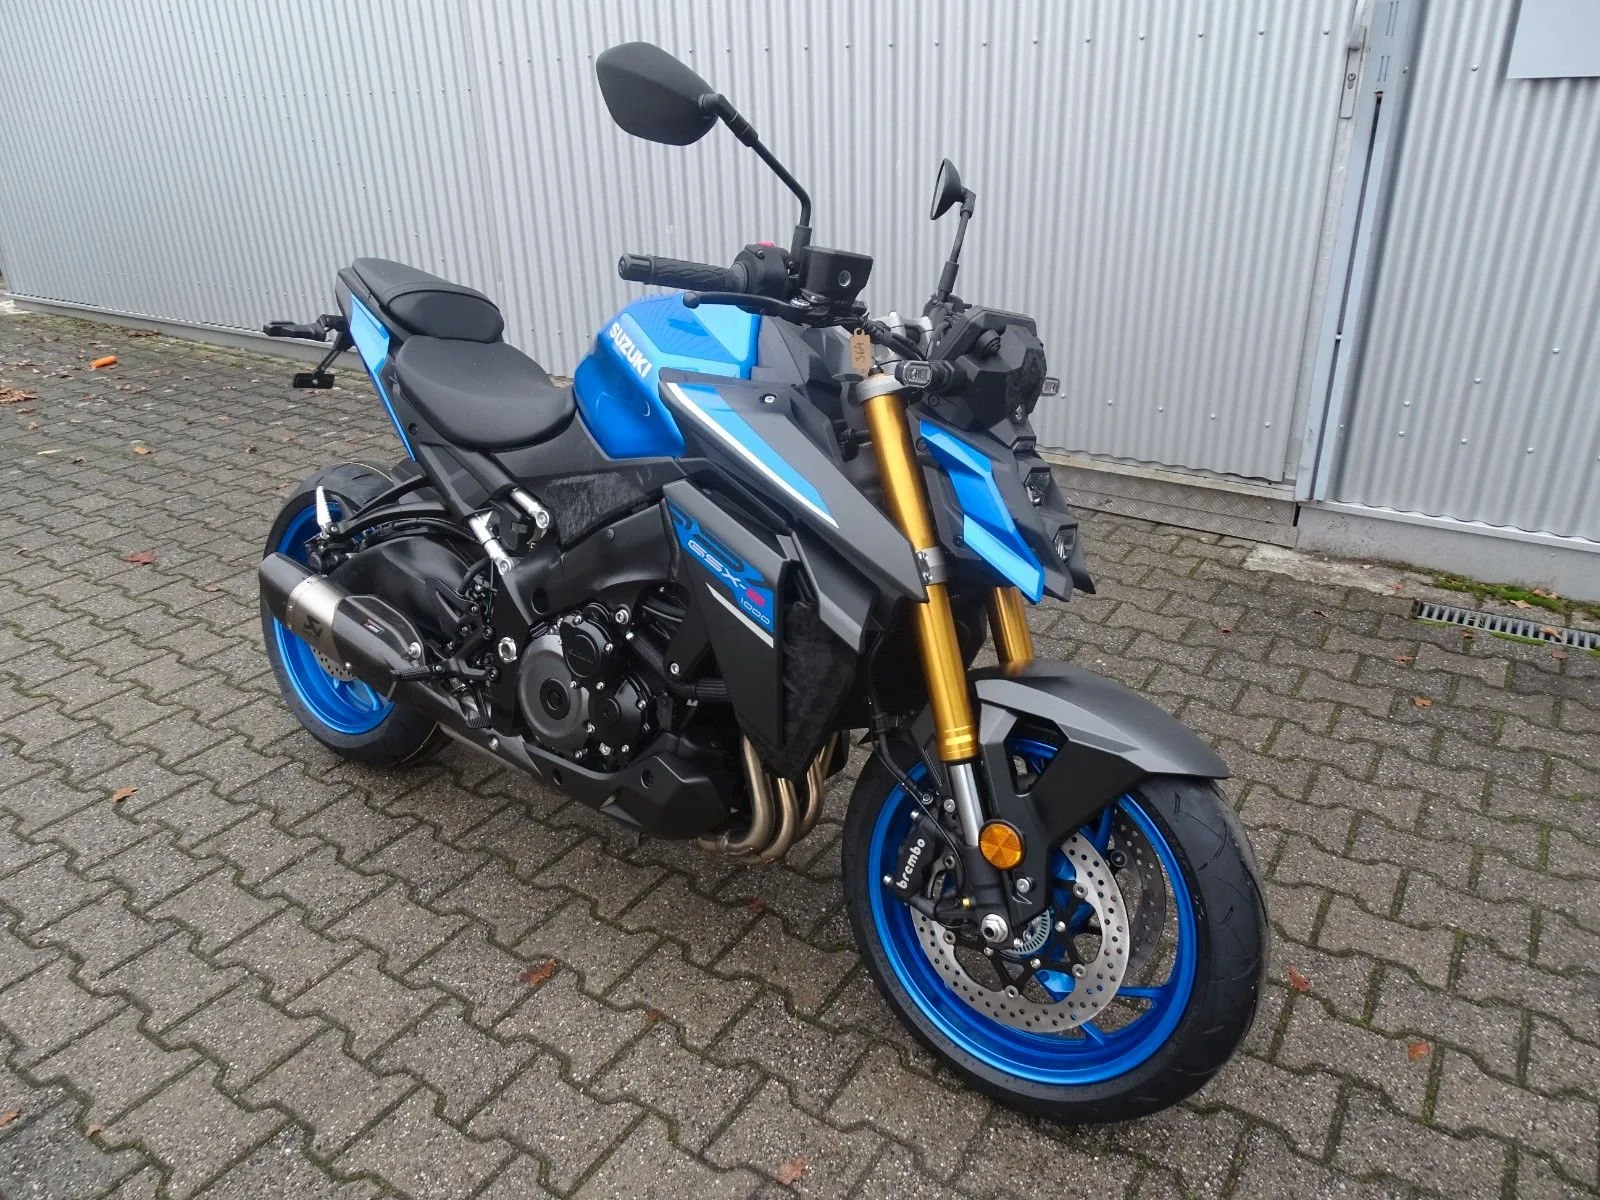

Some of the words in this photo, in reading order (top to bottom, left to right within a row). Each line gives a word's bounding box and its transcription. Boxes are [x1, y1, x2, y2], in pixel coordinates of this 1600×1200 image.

[609, 321, 653, 378] SUZUKI
[688, 539, 766, 608] GSX-S
[740, 597, 771, 625] 1000
[896, 838, 926, 890] brembo
